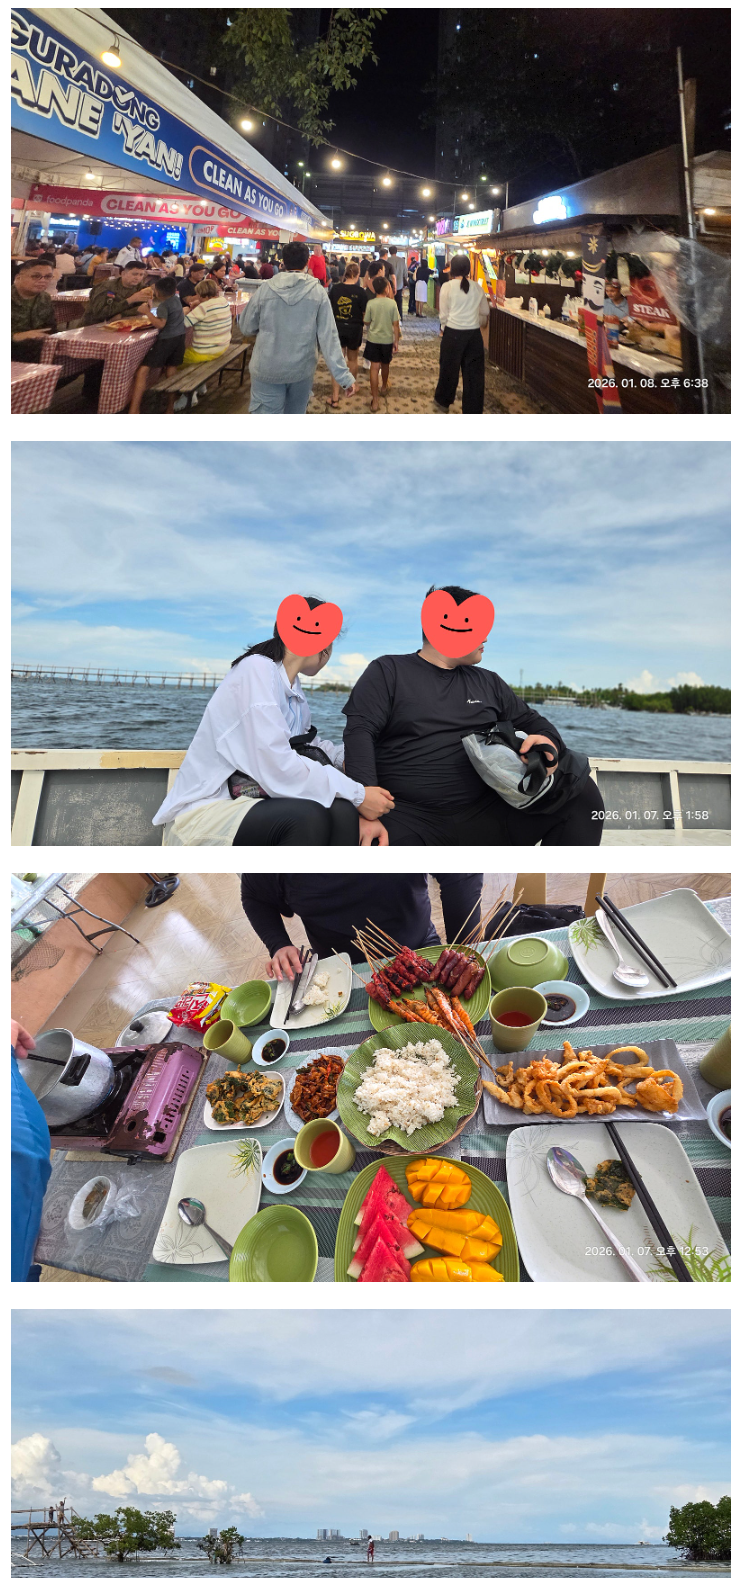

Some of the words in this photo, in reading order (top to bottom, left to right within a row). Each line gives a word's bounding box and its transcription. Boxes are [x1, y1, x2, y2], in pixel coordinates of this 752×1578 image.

[203, 160, 242, 198] CLEAN
[244, 187, 257, 205] AS
[258, 193, 274, 213] YOU
[274, 200, 284, 218] GO
[47, 195, 94, 207] foodpanda
[106, 199, 156, 213] CLEAN
[157, 203, 180, 215] AS
[182, 204, 215, 217] YOU
[217, 206, 241, 219] GO
[228, 227, 254, 235] CLEAN
[633, 303, 670, 319] STEAK
